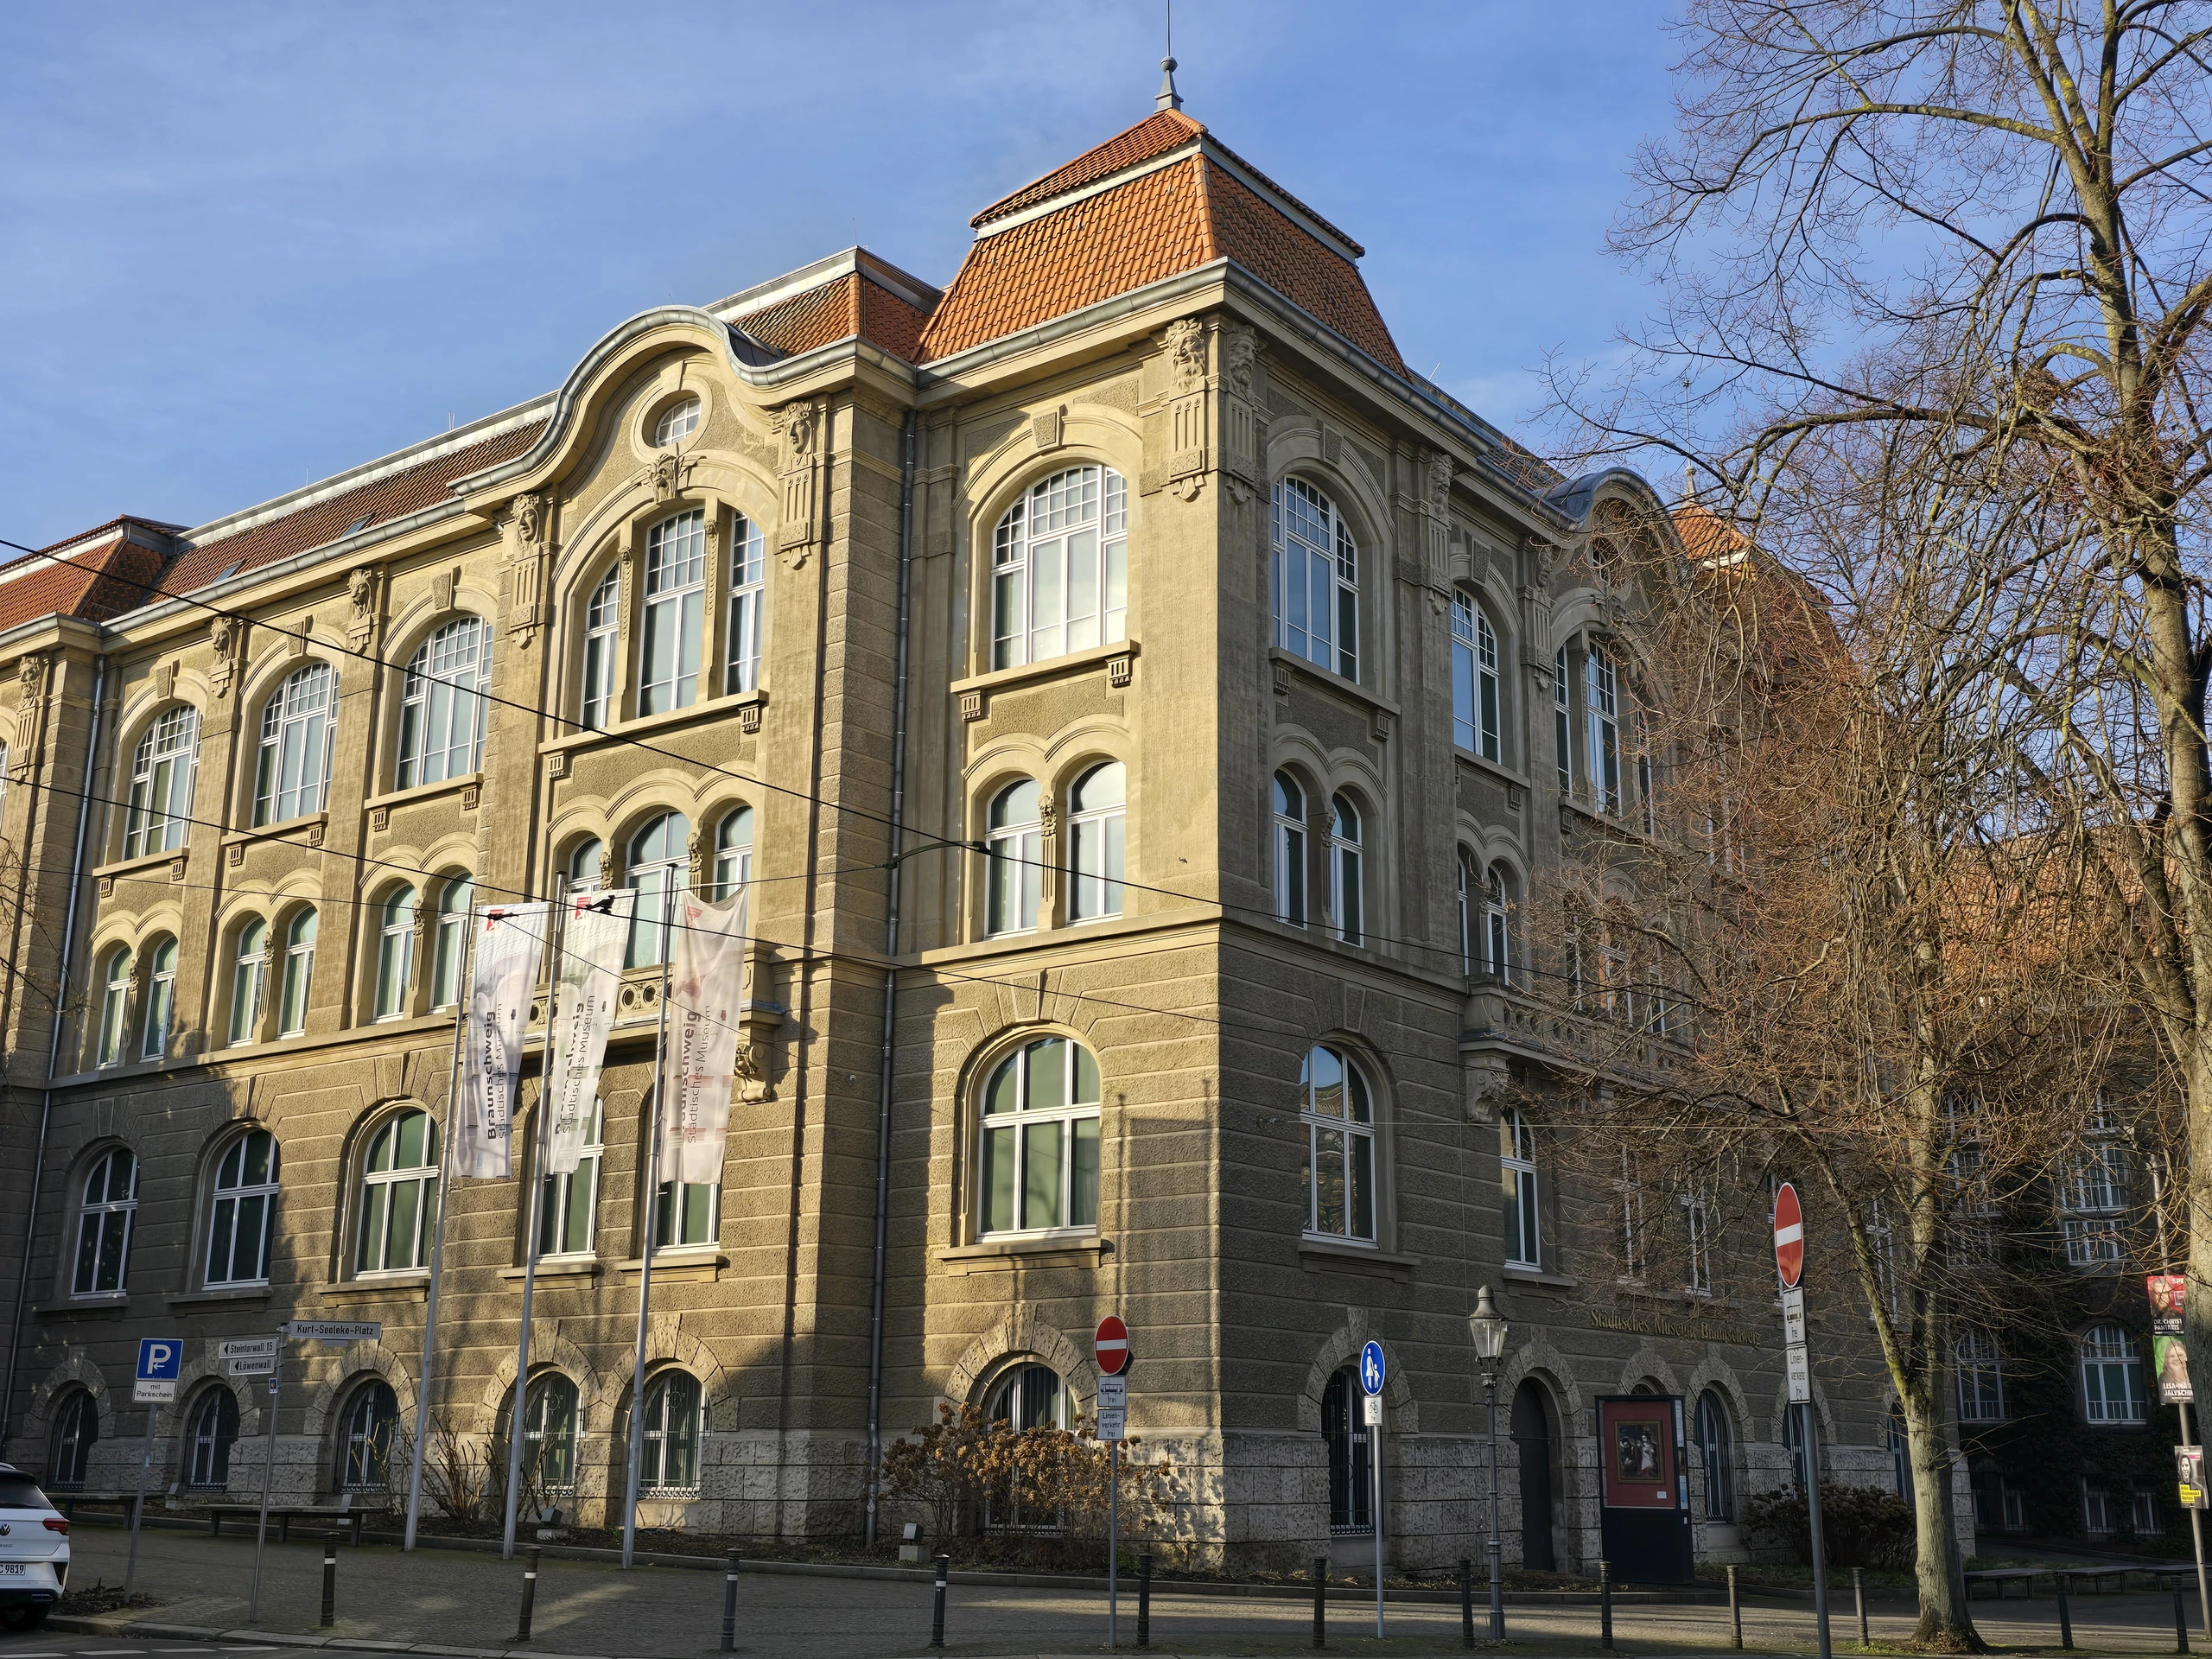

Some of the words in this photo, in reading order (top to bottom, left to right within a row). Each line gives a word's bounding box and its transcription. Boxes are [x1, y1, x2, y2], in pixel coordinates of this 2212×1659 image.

[695, 1005, 711, 1064] Museum
[563, 1057, 585, 1134] Städtisches
[578, 995, 595, 1053] Museum
[484, 1011, 497, 1140] Braunschweig
[688, 1066, 704, 1144] Städtisches
[296, 1324, 374, 1335] Kurt-Seeleke-Platz
[230, 1342, 264, 1354] Steintorwall
[266, 1341, 273, 1351] 15
[147, 1344, 172, 1374] P
[239, 1359, 271, 1370] Löwenwall
[1103, 1411, 1121, 1420] Linien-
[5, 1564, 24, 1574] 9819
